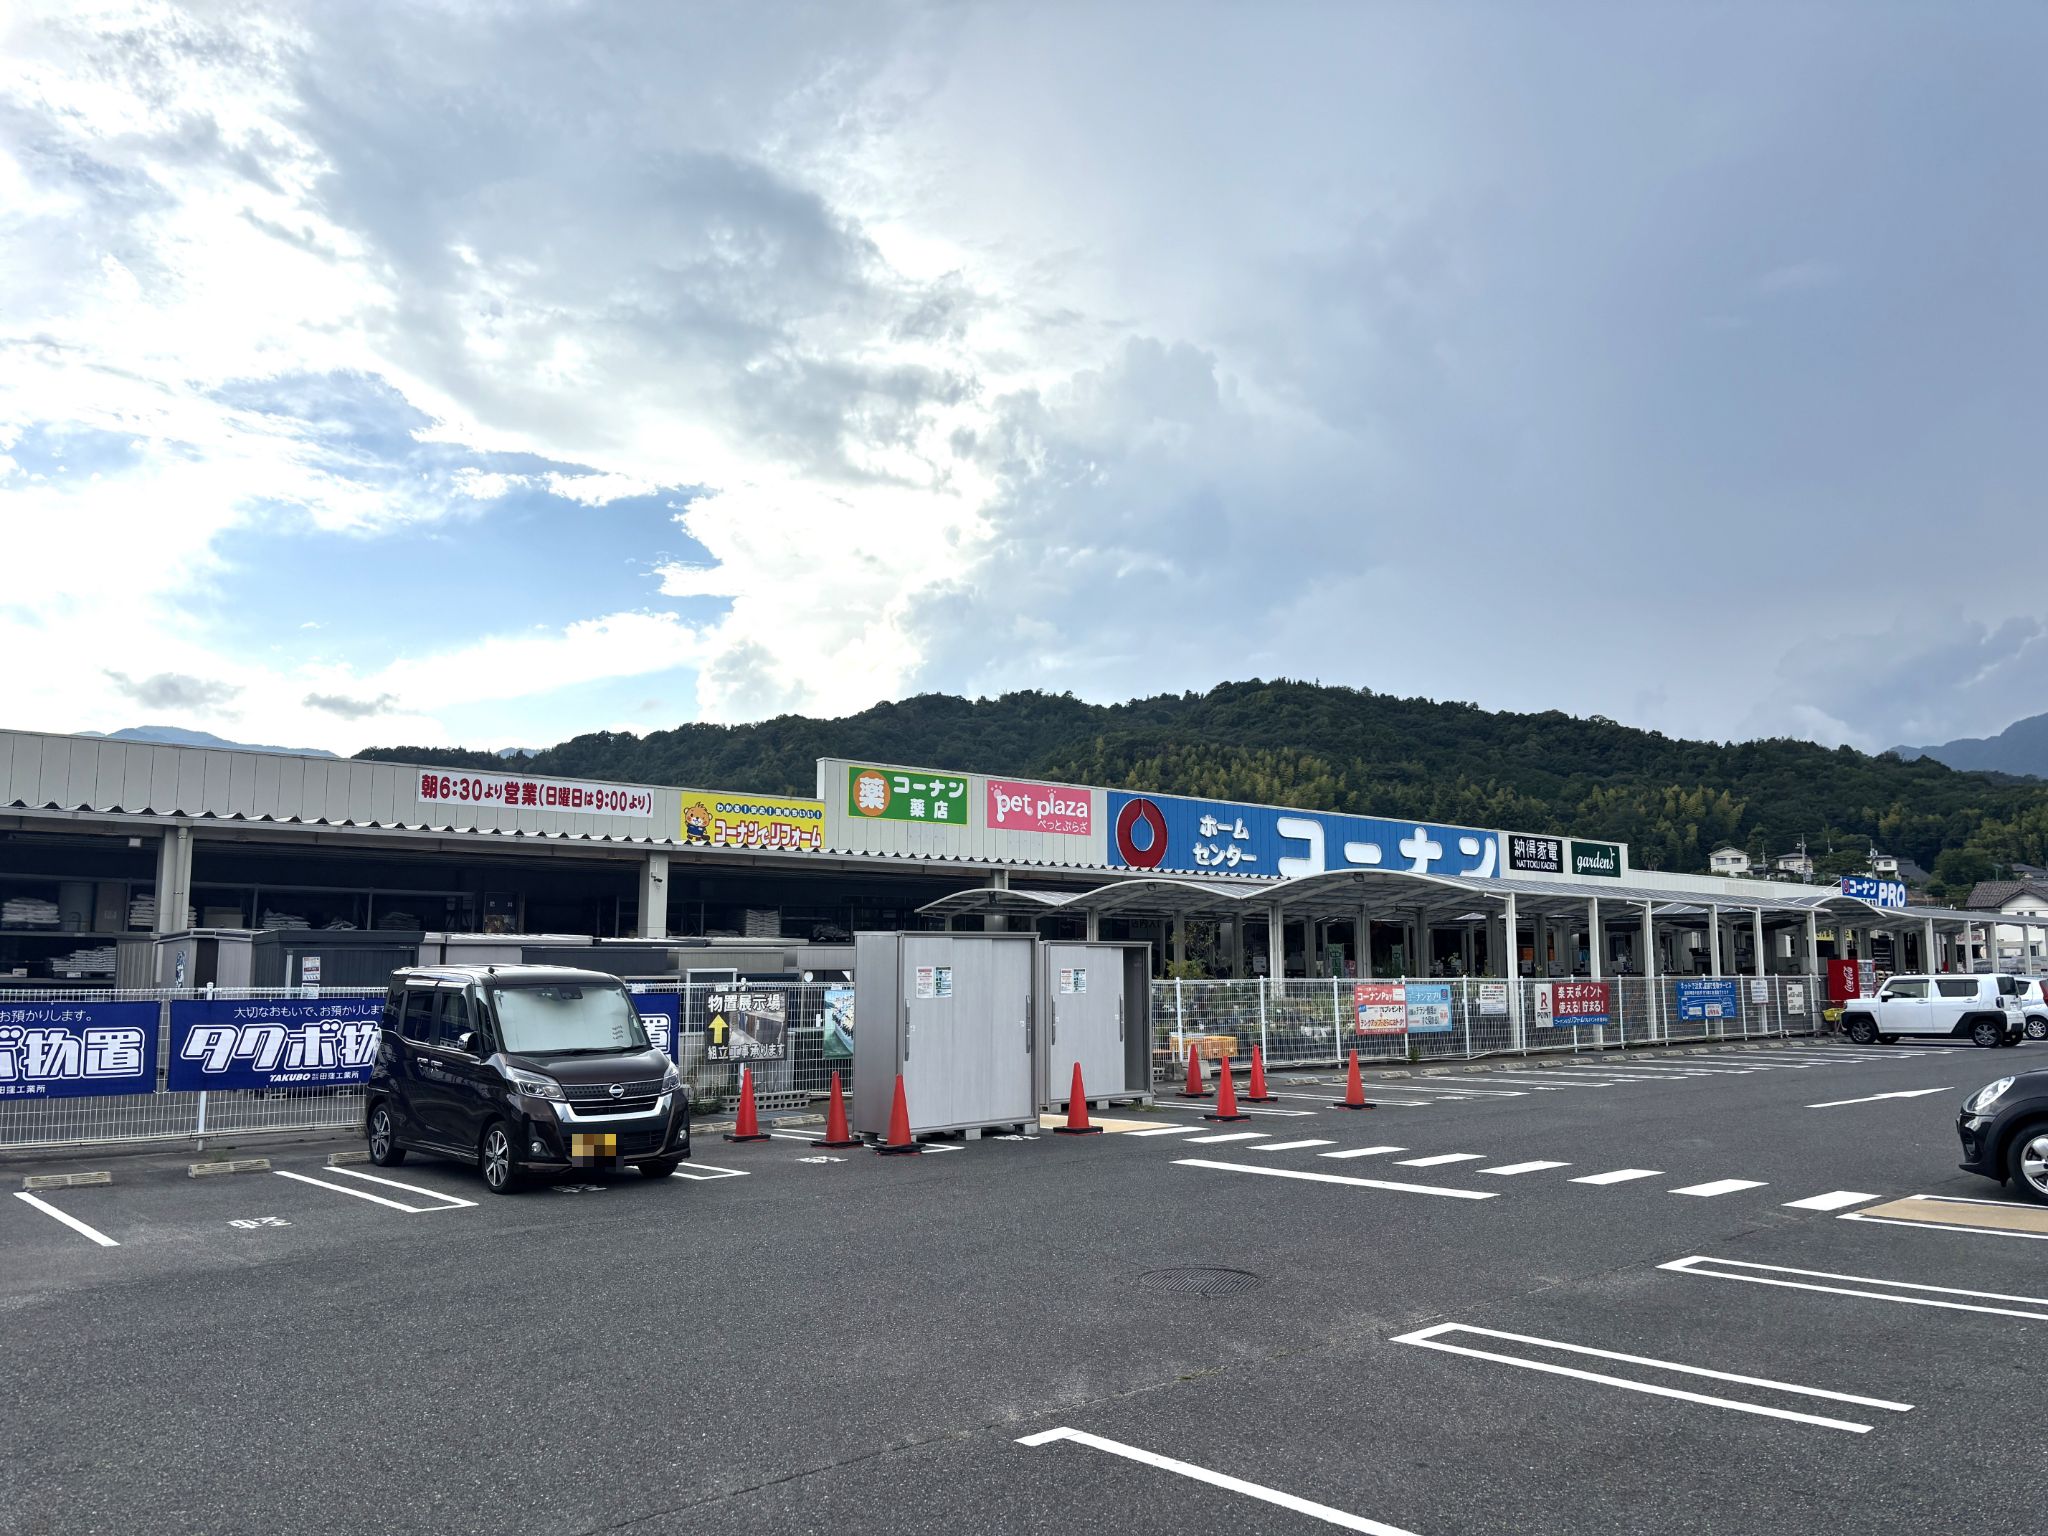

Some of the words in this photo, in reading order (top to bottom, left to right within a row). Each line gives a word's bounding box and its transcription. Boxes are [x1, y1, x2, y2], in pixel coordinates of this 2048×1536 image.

[859, 777, 884, 809] 薬
[893, 776, 964, 798] コーナン
[993, 789, 1033, 823] pet
[1037, 790, 1088, 819] plaza
[715, 818, 822, 848] コーナンでリフォーム
[1200, 814, 1250, 840] ホーム
[1193, 842, 1257, 868] センター
[1277, 816, 1497, 878] コーナン
[1514, 838, 1558, 861] 納得家電
[1849, 879, 1877, 895] コーナン
[1878, 882, 1906, 907] PRO
[707, 993, 781, 1012] 物置展示場
[1357, 992, 1393, 1002] コーナンPay
[1541, 992, 1548, 1007] R
[1558, 985, 1602, 999] 楽天ポイント
[1537, 1011, 1551, 1019] POINT
[707, 1043, 785, 1060] 組立工事承ります
[269, 1073, 311, 1082] TAKUBO
